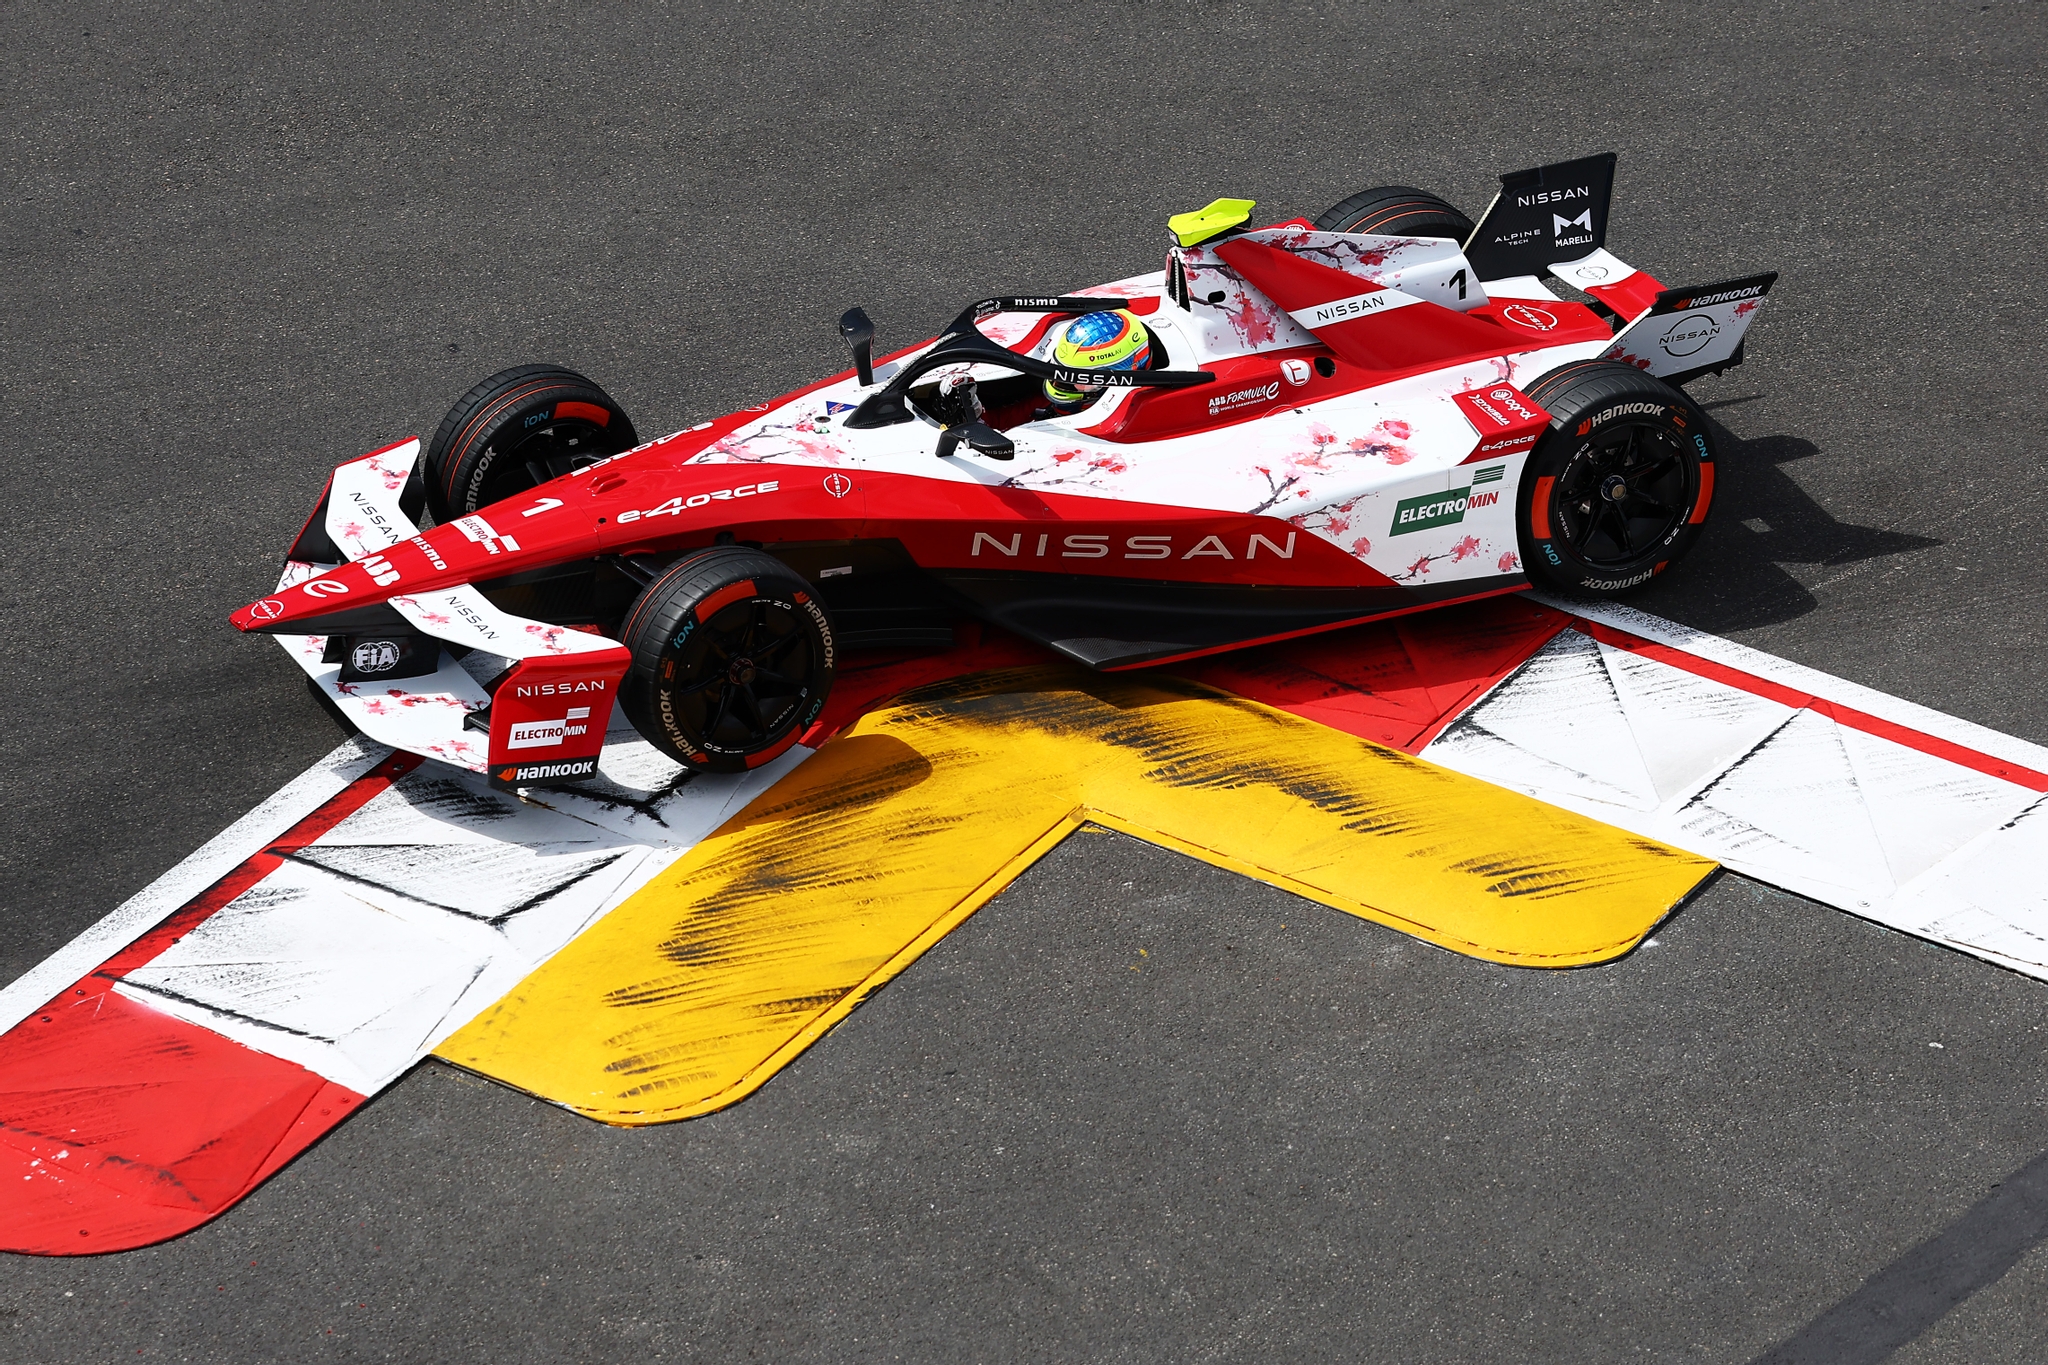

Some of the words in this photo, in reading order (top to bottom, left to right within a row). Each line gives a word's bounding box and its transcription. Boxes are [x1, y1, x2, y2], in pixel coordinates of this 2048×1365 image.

[1518, 186, 1590, 207] NISSAN
[1494, 229, 1541, 243] ALPINE
[1508, 238, 1529, 246] TECH
[1555, 234, 1593, 248] MARELLI
[1449, 269, 1467, 301] 1
[1316, 296, 1385, 321] NISSAN
[1659, 323, 1721, 345] NISSAN
[1053, 370, 1133, 386] NISSAN
[1208, 395, 1226, 407] ABB
[1226, 385, 1267, 405] FORMULA
[350, 492, 402, 544] NISSAN
[521, 498, 564, 517] 1
[1399, 491, 1499, 524] ELECTROMIN
[462, 518, 500, 555] ELECTROMIN
[971, 531, 1297, 560] NISSAN
[356, 554, 401, 587] ABB
[449, 596, 500, 640] NISSAN
[518, 680, 606, 697] NISSAN
[769, 703, 794, 728] NISSAN
[514, 725, 588, 742] ELECTROMIN
